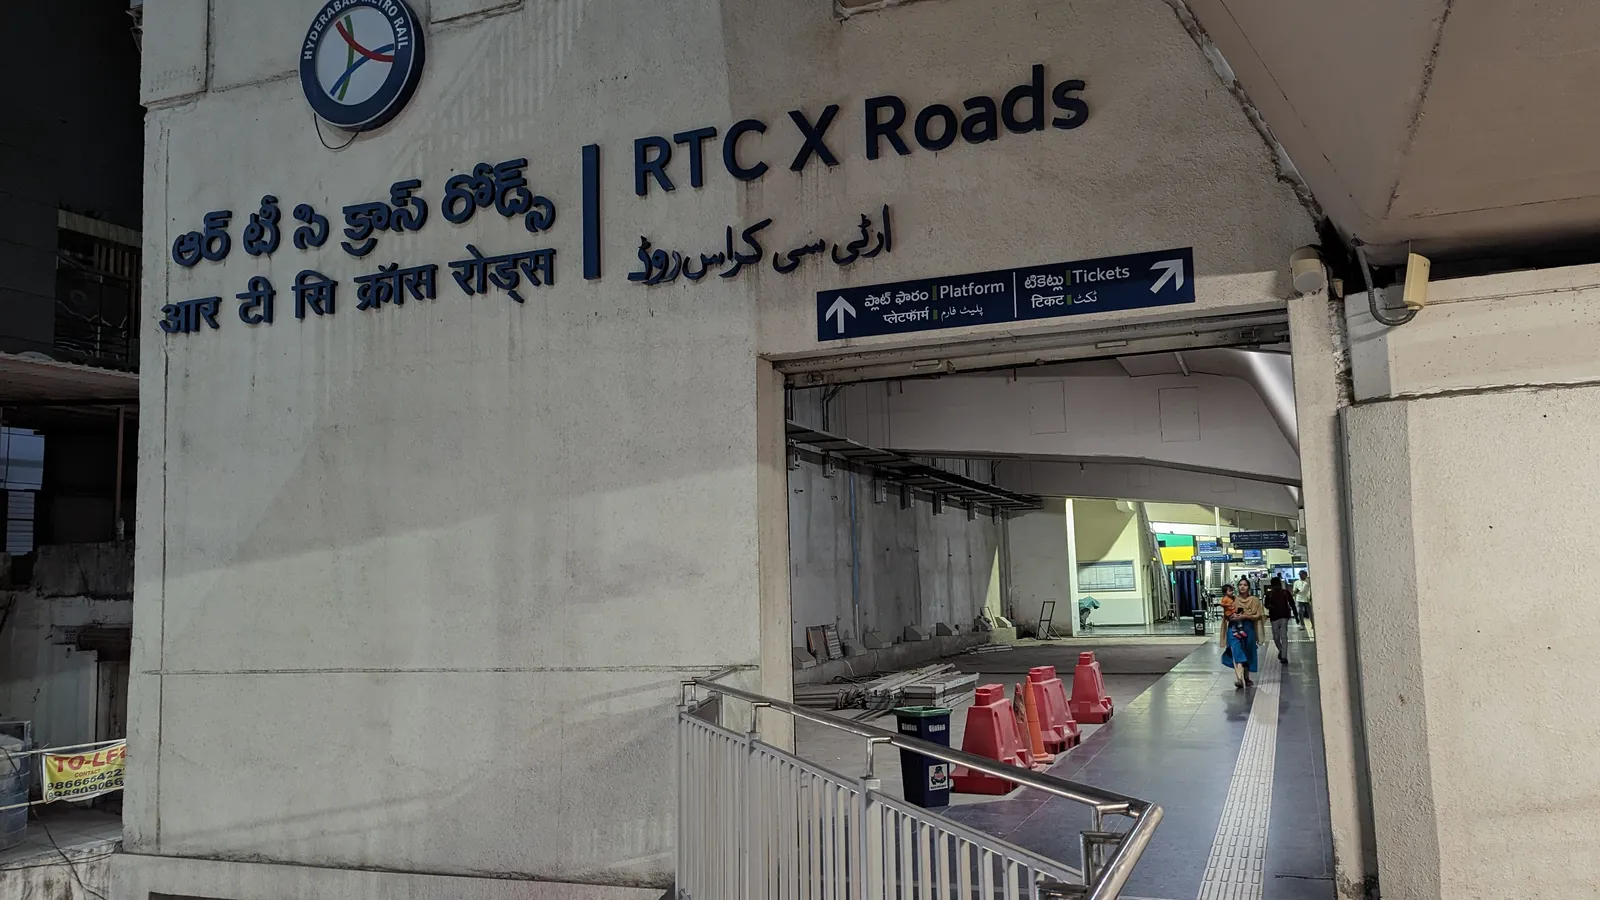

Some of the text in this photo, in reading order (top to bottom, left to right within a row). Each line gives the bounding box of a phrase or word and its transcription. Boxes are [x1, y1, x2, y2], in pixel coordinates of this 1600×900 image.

[394, 16, 409, 50] RAIL
[634, 63, 1091, 198] RTC X Roads
[171, 209, 233, 267] ఆర్
[243, 194, 282, 256] టీ
[293, 203, 330, 250] సి
[341, 178, 429, 257] క్రాస్
[1072, 265, 1131, 284] Tickets
[160, 243, 557, 334] आर टी सि क्रॉस रोड्स
[939, 281, 1005, 299] Platform
[1031, 294, 1065, 309] टिकट
[74, 768, 101, 778] CONTACT
